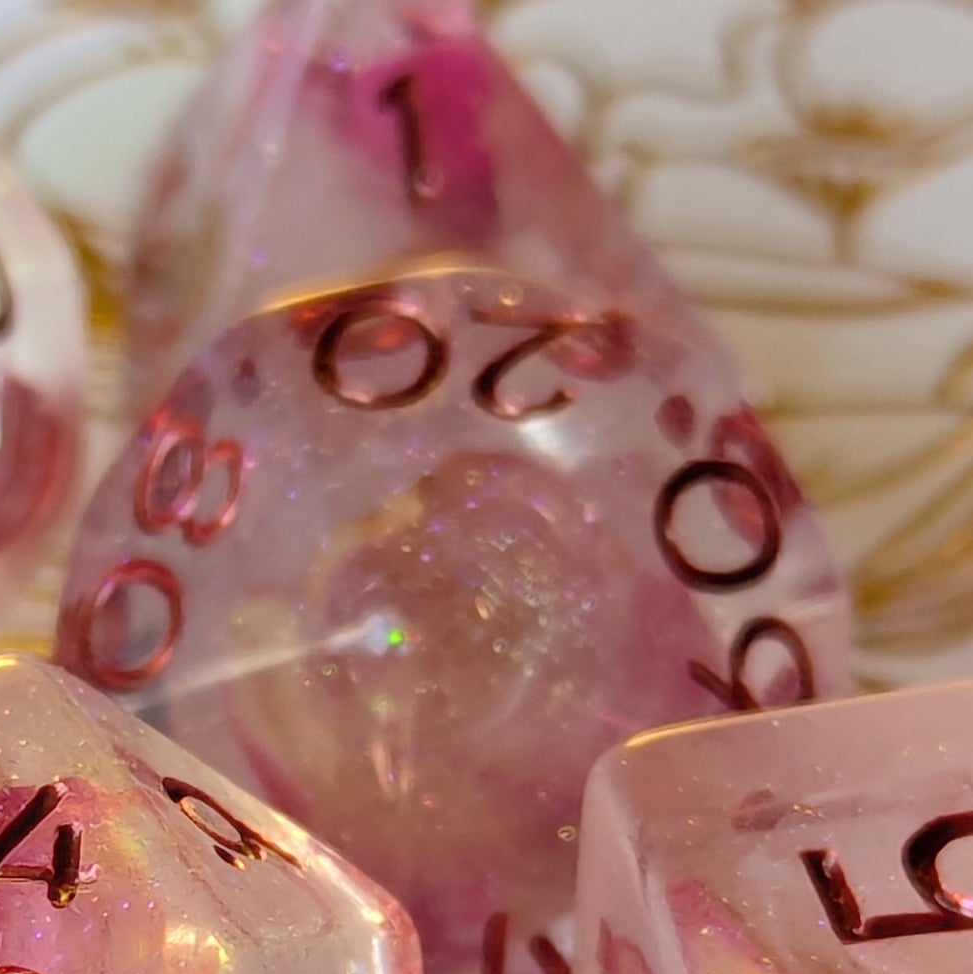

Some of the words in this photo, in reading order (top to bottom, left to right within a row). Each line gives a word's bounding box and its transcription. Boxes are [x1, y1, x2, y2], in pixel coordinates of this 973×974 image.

[377, 70, 427, 213] 1
[311, 303, 609, 422] 20
[76, 415, 246, 692] 80
